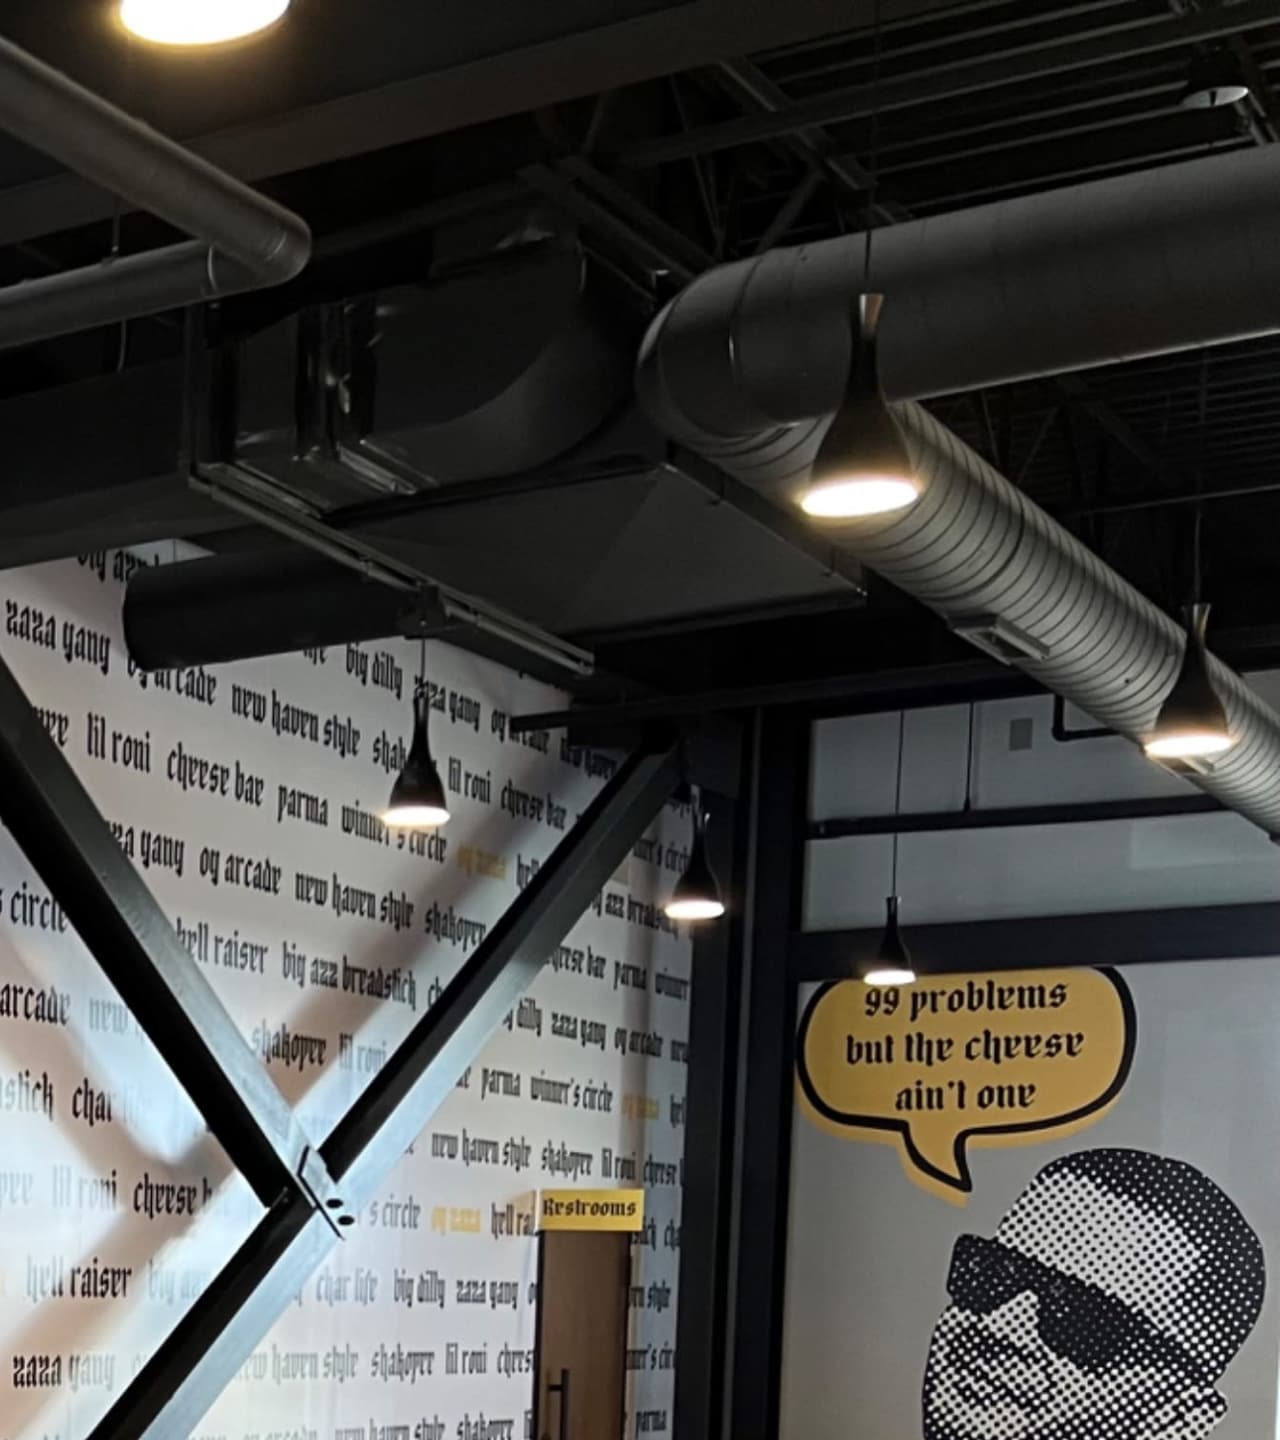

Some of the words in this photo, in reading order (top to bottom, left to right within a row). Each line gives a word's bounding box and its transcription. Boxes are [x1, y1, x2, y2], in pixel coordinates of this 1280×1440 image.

[6, 599, 56, 650] zaza
[62, 620, 111, 675] gang
[231, 684, 267, 723] new
[272, 689, 319, 743] haven
[324, 714, 360, 758] style
[87, 712, 106, 759] lil
[112, 730, 151, 774] roni
[167, 741, 229, 797] cheese
[235, 760, 264, 807] bae
[277, 784, 328, 827] parma
[140, 829, 185, 877] gang
[199, 846, 219, 885] og
[224, 857, 281, 896] arcade
[295, 872, 328, 905] new
[332, 873, 376, 920] haven
[380, 890, 414, 933] style
[214, 930, 269, 975] raiser
[283, 940, 306, 988] big
[310, 957, 339, 989] azz
[342, 955, 416, 1012] breadstick
[0, 983, 71, 1027] arcade
[864, 986, 901, 1017] 99
[909, 979, 1069, 1023] problems
[845, 1034, 894, 1066] but
[904, 1031, 953, 1067] the
[965, 1028, 1085, 1065] cheese
[481, 1065, 521, 1100] parma
[895, 1079, 967, 1113] ain't
[976, 1082, 1037, 1110] one
[431, 1130, 459, 1160] new
[462, 1128, 499, 1167] haven
[502, 1136, 531, 1172] style
[541, 1139, 593, 1181] shakopee
[133, 1172, 198, 1220] cheese
[382, 1194, 421, 1229] circle
[491, 1202, 513, 1240] hell
[543, 1197, 637, 1217] Restrooms
[26, 1256, 63, 1303] hell
[70, 1256, 132, 1299] raiser
[394, 1268, 414, 1308] big
[417, 1270, 445, 1309] dilly
[456, 1279, 486, 1304] zaza
[490, 1281, 519, 1309] gang
[12, 1353, 62, 1389] zaza
[68, 1354, 117, 1395] gang
[271, 1344, 319, 1385] haven
[323, 1345, 359, 1383] style
[370, 1342, 435, 1384] shakopee
[445, 1342, 458, 1374] lil
[461, 1342, 487, 1374] roni
